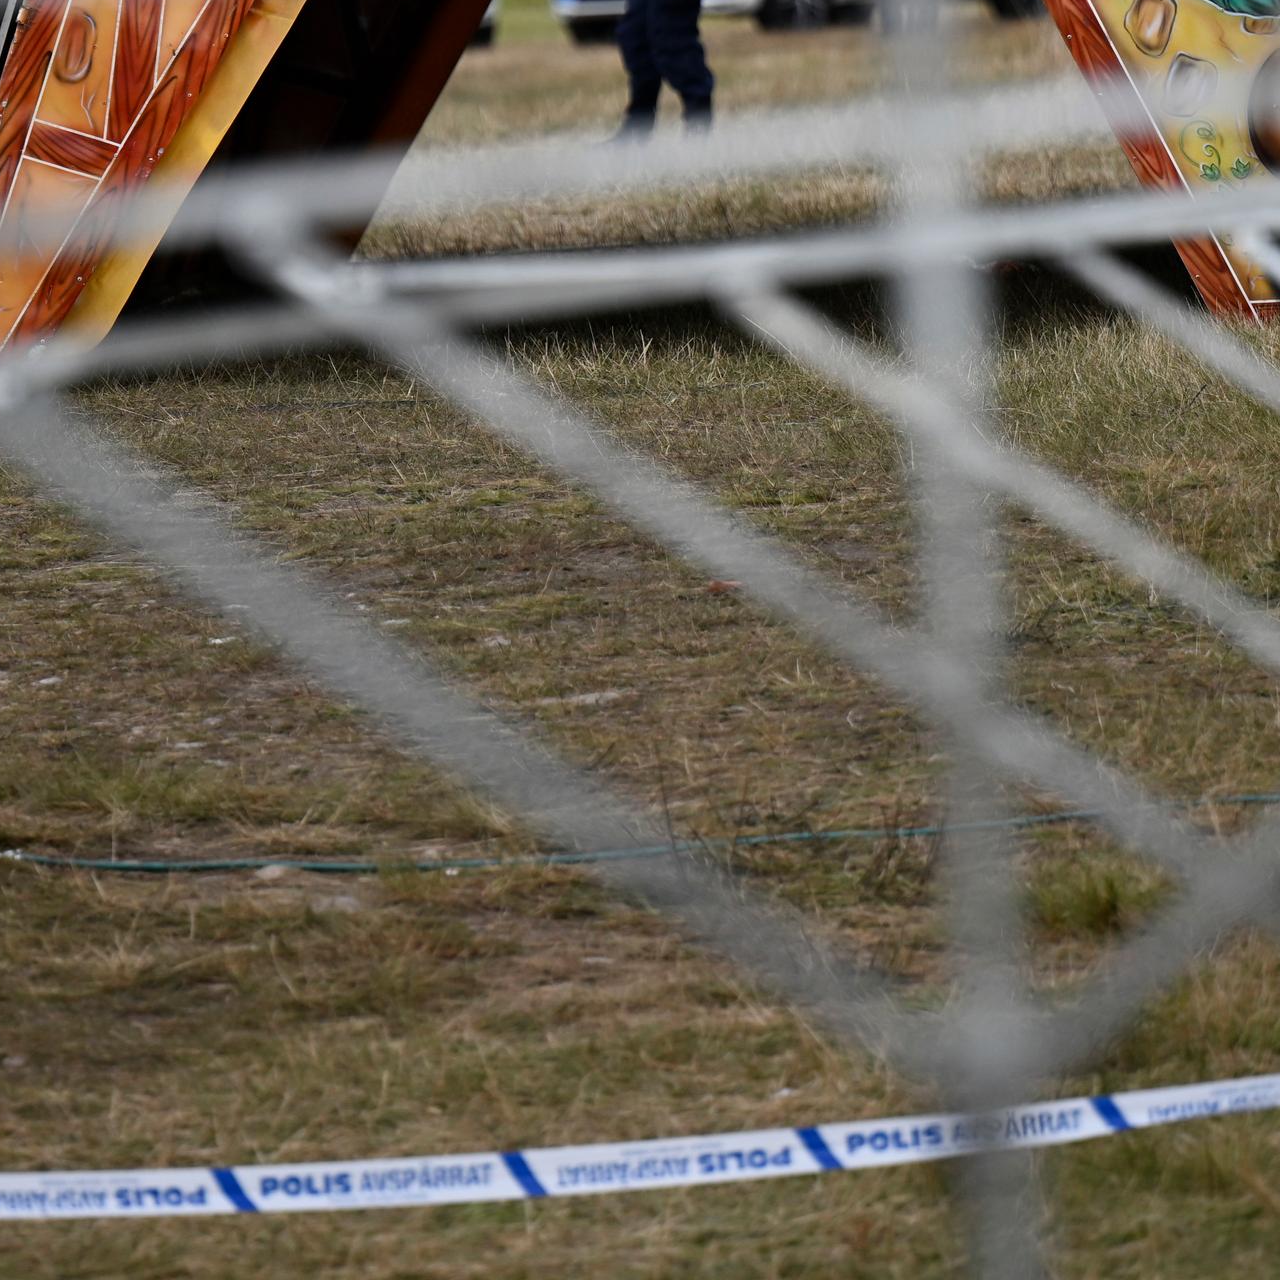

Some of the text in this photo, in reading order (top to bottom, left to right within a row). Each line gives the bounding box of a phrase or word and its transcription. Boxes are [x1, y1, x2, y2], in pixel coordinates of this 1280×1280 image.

[846, 1108, 1083, 1153] POLIS APÄRRAT
[698, 1148, 793, 1173] POLIS
[261, 1163, 493, 1197] POLIS AVSPÄRRAT
[115, 1186, 207, 1209] POLIS
